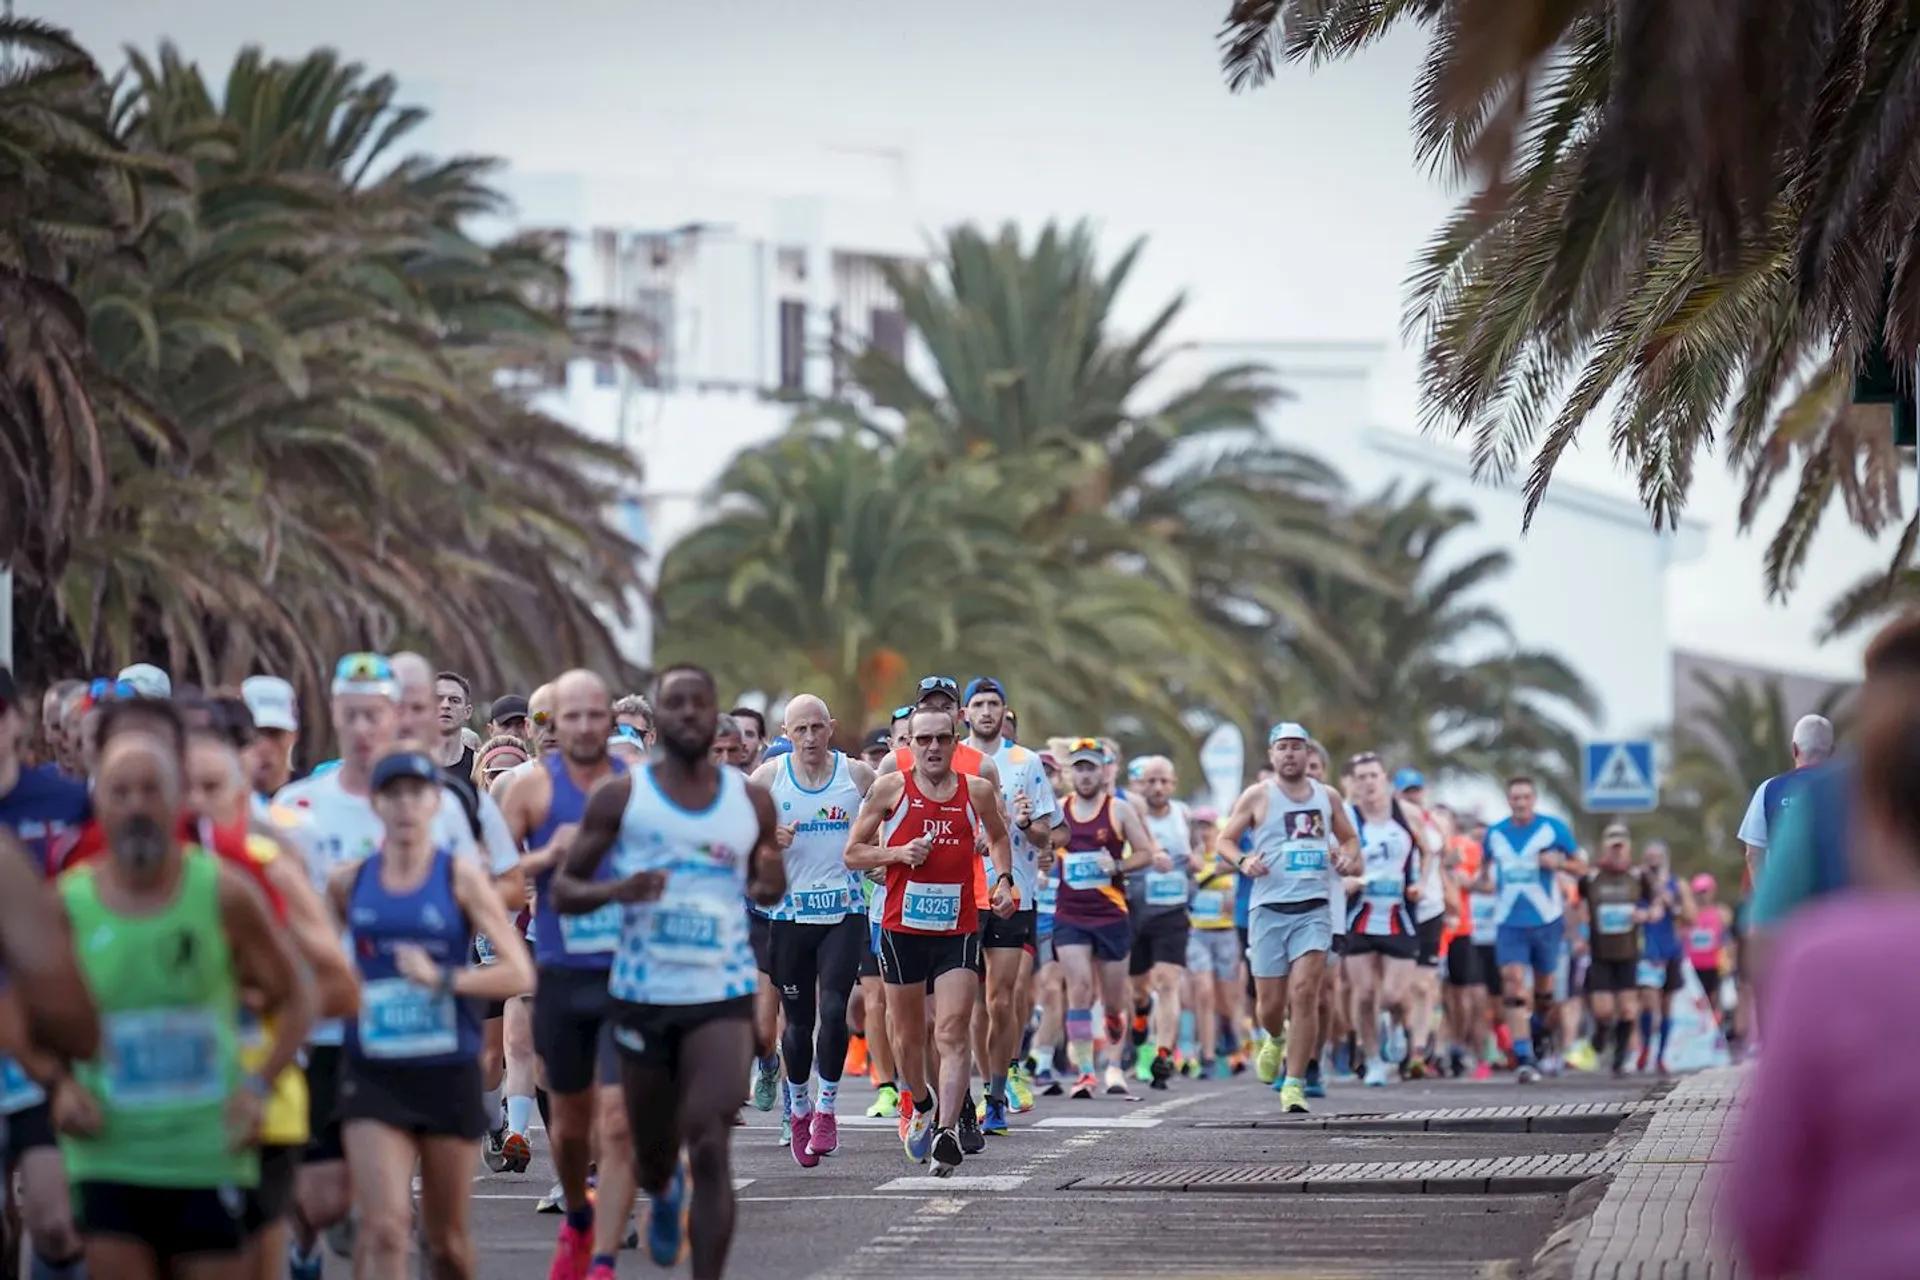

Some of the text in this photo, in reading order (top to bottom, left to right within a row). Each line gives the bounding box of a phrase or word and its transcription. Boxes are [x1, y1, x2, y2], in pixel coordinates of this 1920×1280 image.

[923, 819, 953, 837] DJK
[807, 892, 836, 909] 4107
[915, 897, 949, 915] 4325
